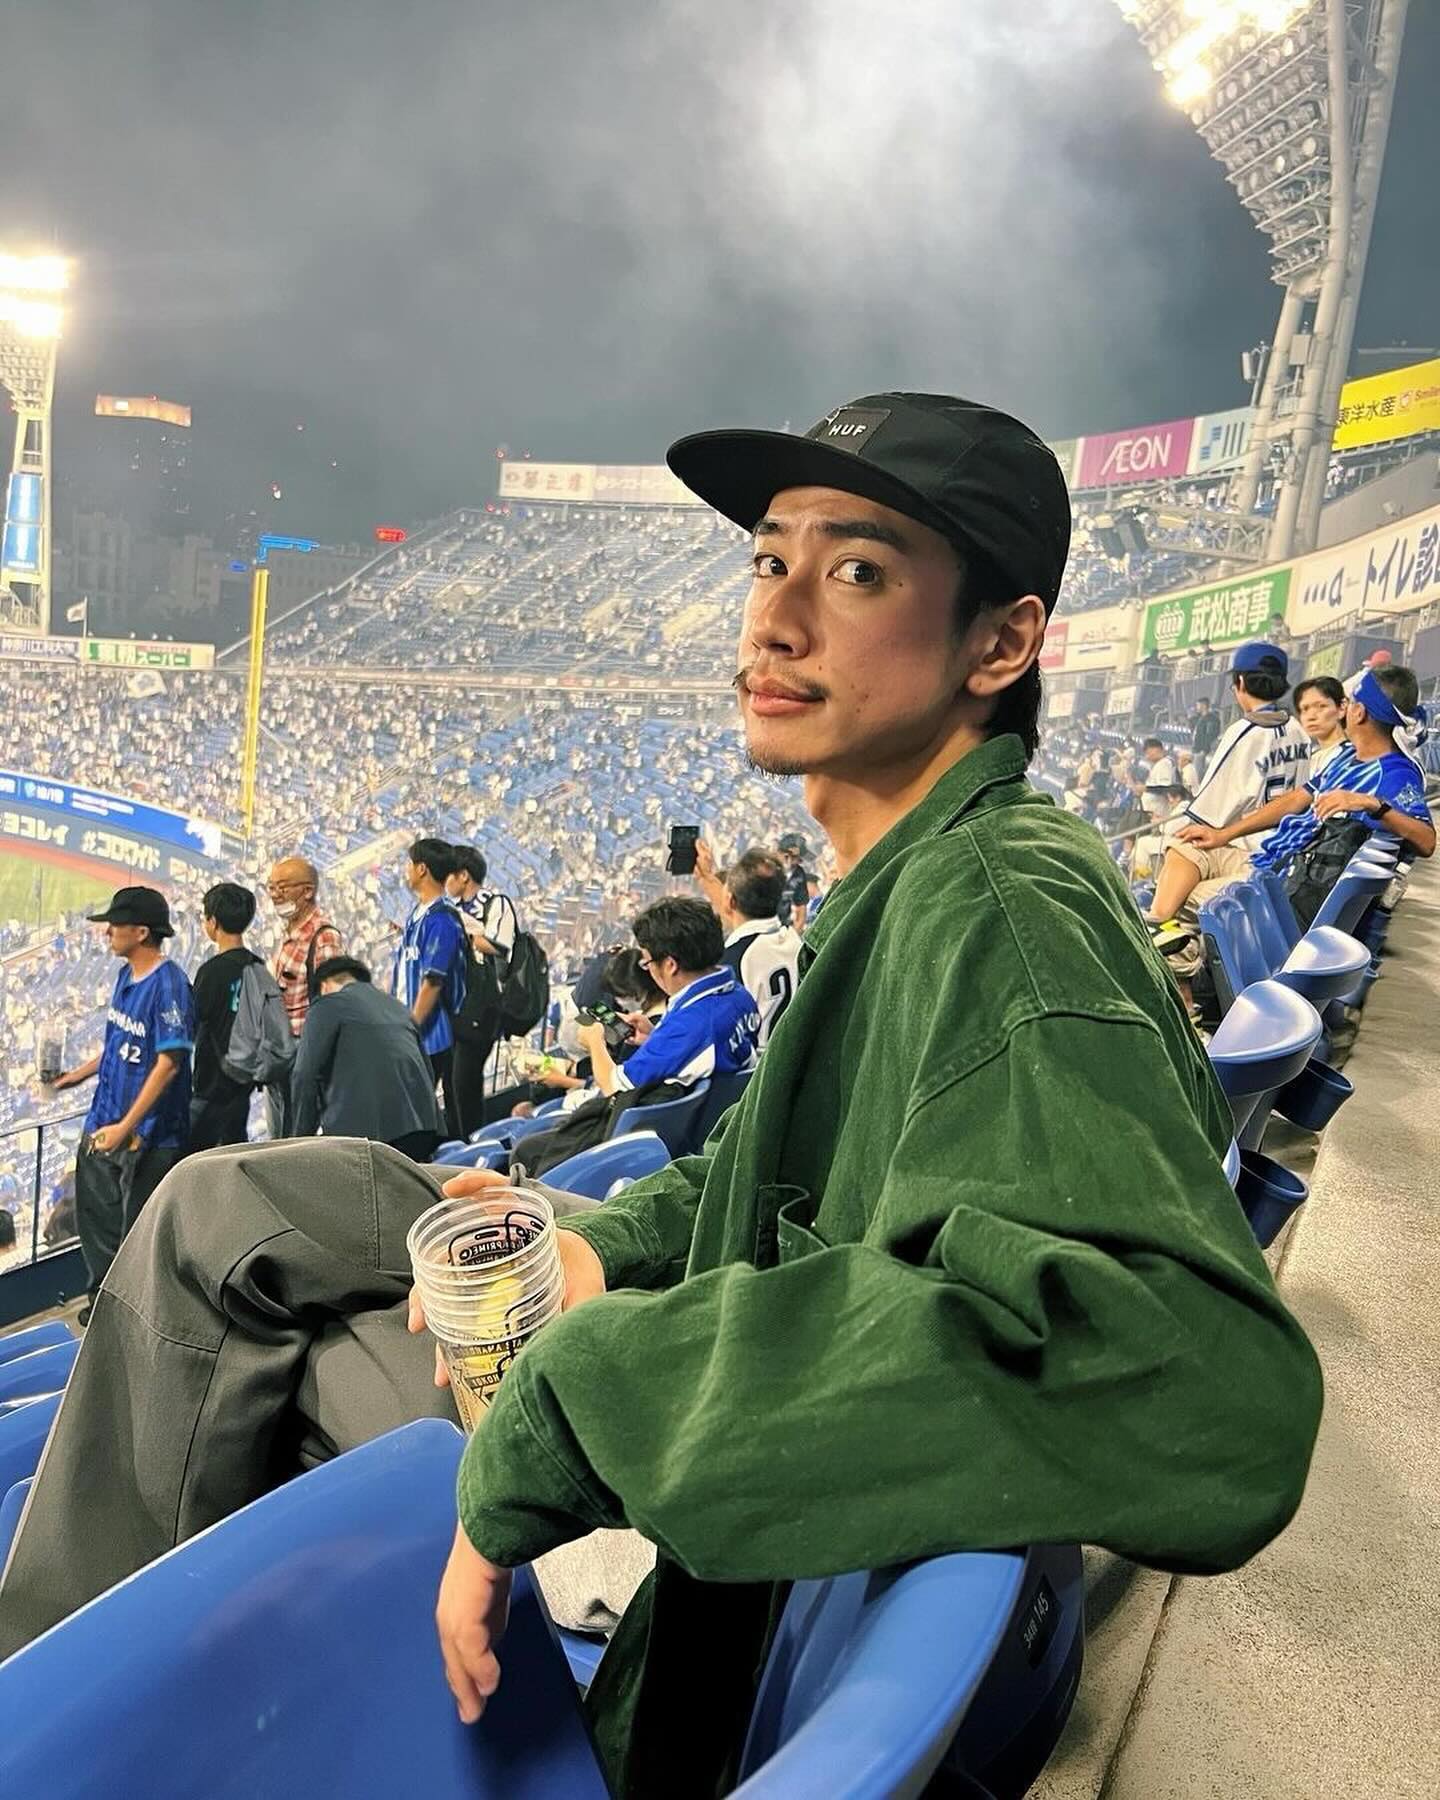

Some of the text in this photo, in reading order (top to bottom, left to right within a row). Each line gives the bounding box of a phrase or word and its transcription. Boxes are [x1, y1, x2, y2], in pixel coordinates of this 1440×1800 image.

[1336, 396, 1397, 425] 東洋水産
[828, 424, 867, 437] HUF
[1362, 522, 1440, 608] トイレ診
[1188, 581, 1274, 642] 武松商事
[119, 1042, 141, 1064] 42
